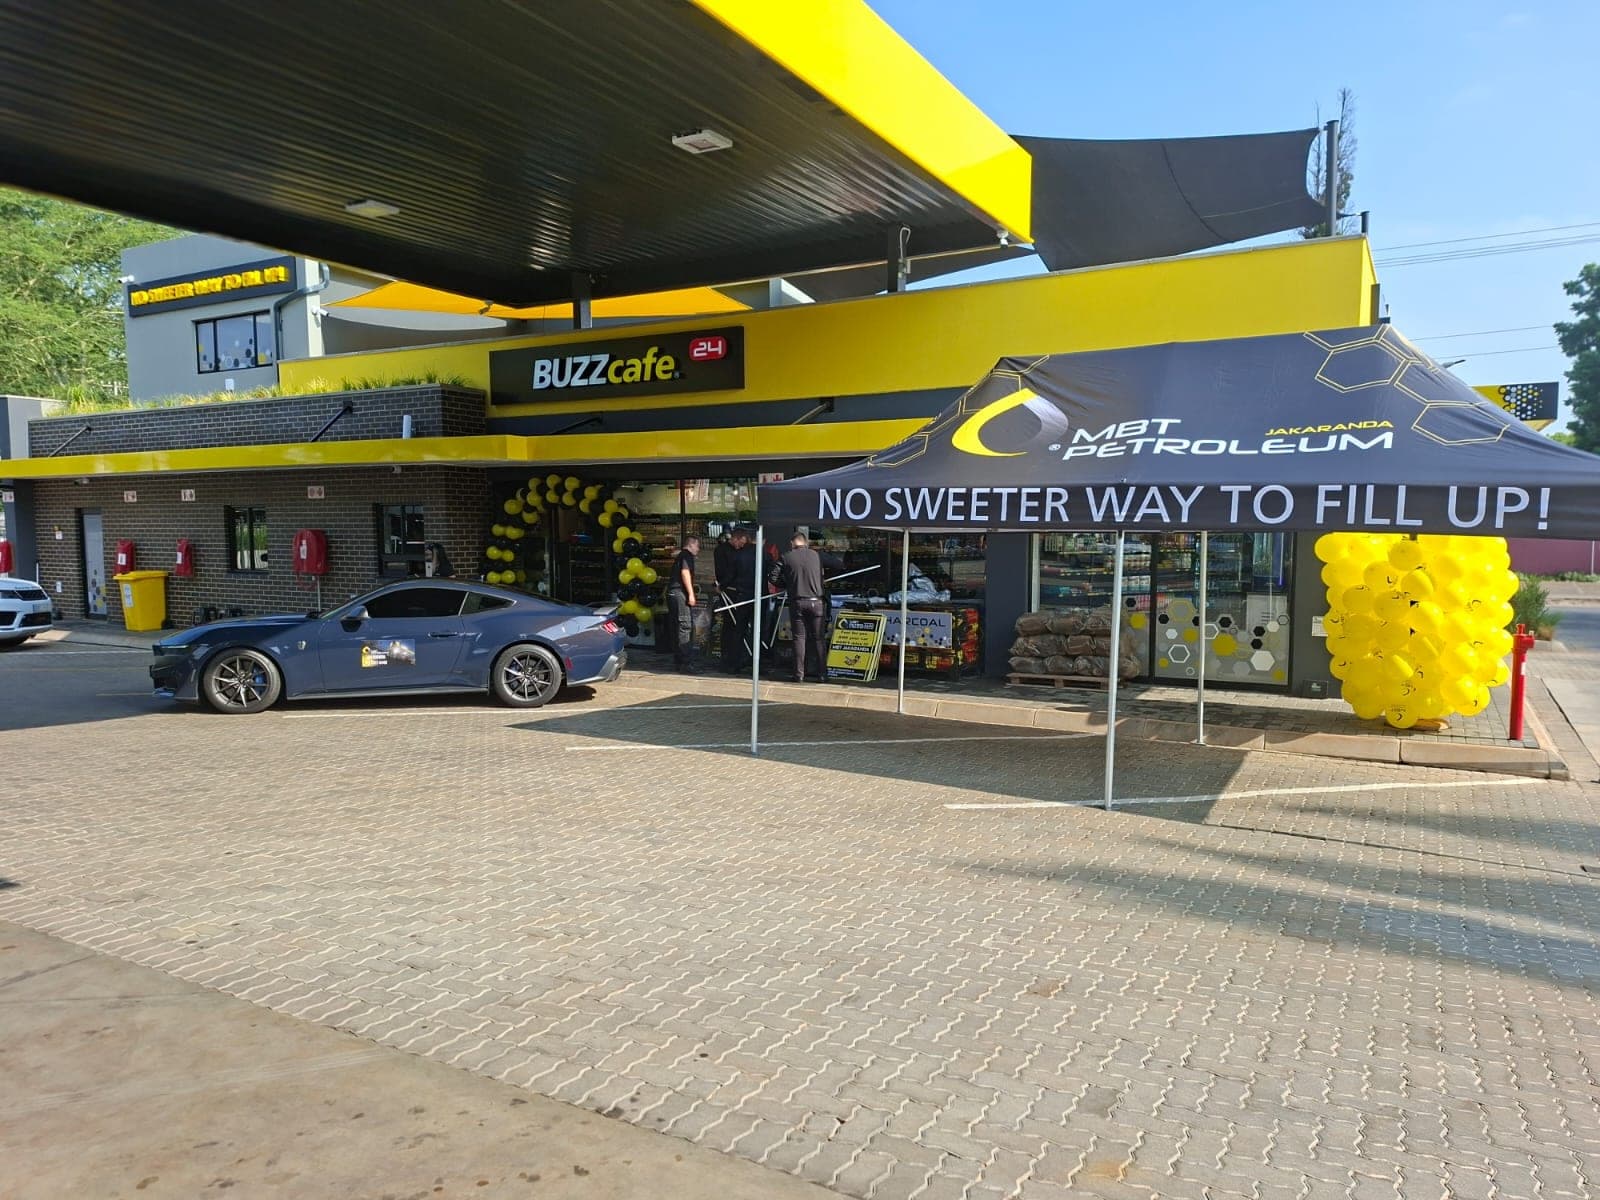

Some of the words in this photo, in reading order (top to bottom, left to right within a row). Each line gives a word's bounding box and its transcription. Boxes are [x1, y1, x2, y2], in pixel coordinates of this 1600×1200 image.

[693, 340, 722, 358] 24
[532, 346, 676, 390] BUZZcafe
[1072, 418, 1182, 444] MBT
[1265, 420, 1394, 436] JAKARANDA
[1062, 432, 1394, 461] PETROLEUM
[818, 488, 872, 520] NO
[884, 487, 1070, 522] SWEETER
[1086, 486, 1204, 523] WAY
[1220, 485, 1295, 525] TO
[1316, 484, 1423, 526] FILL
[1448, 486, 1550, 530] UP!
[886, 616, 946, 627] HARCOAL
